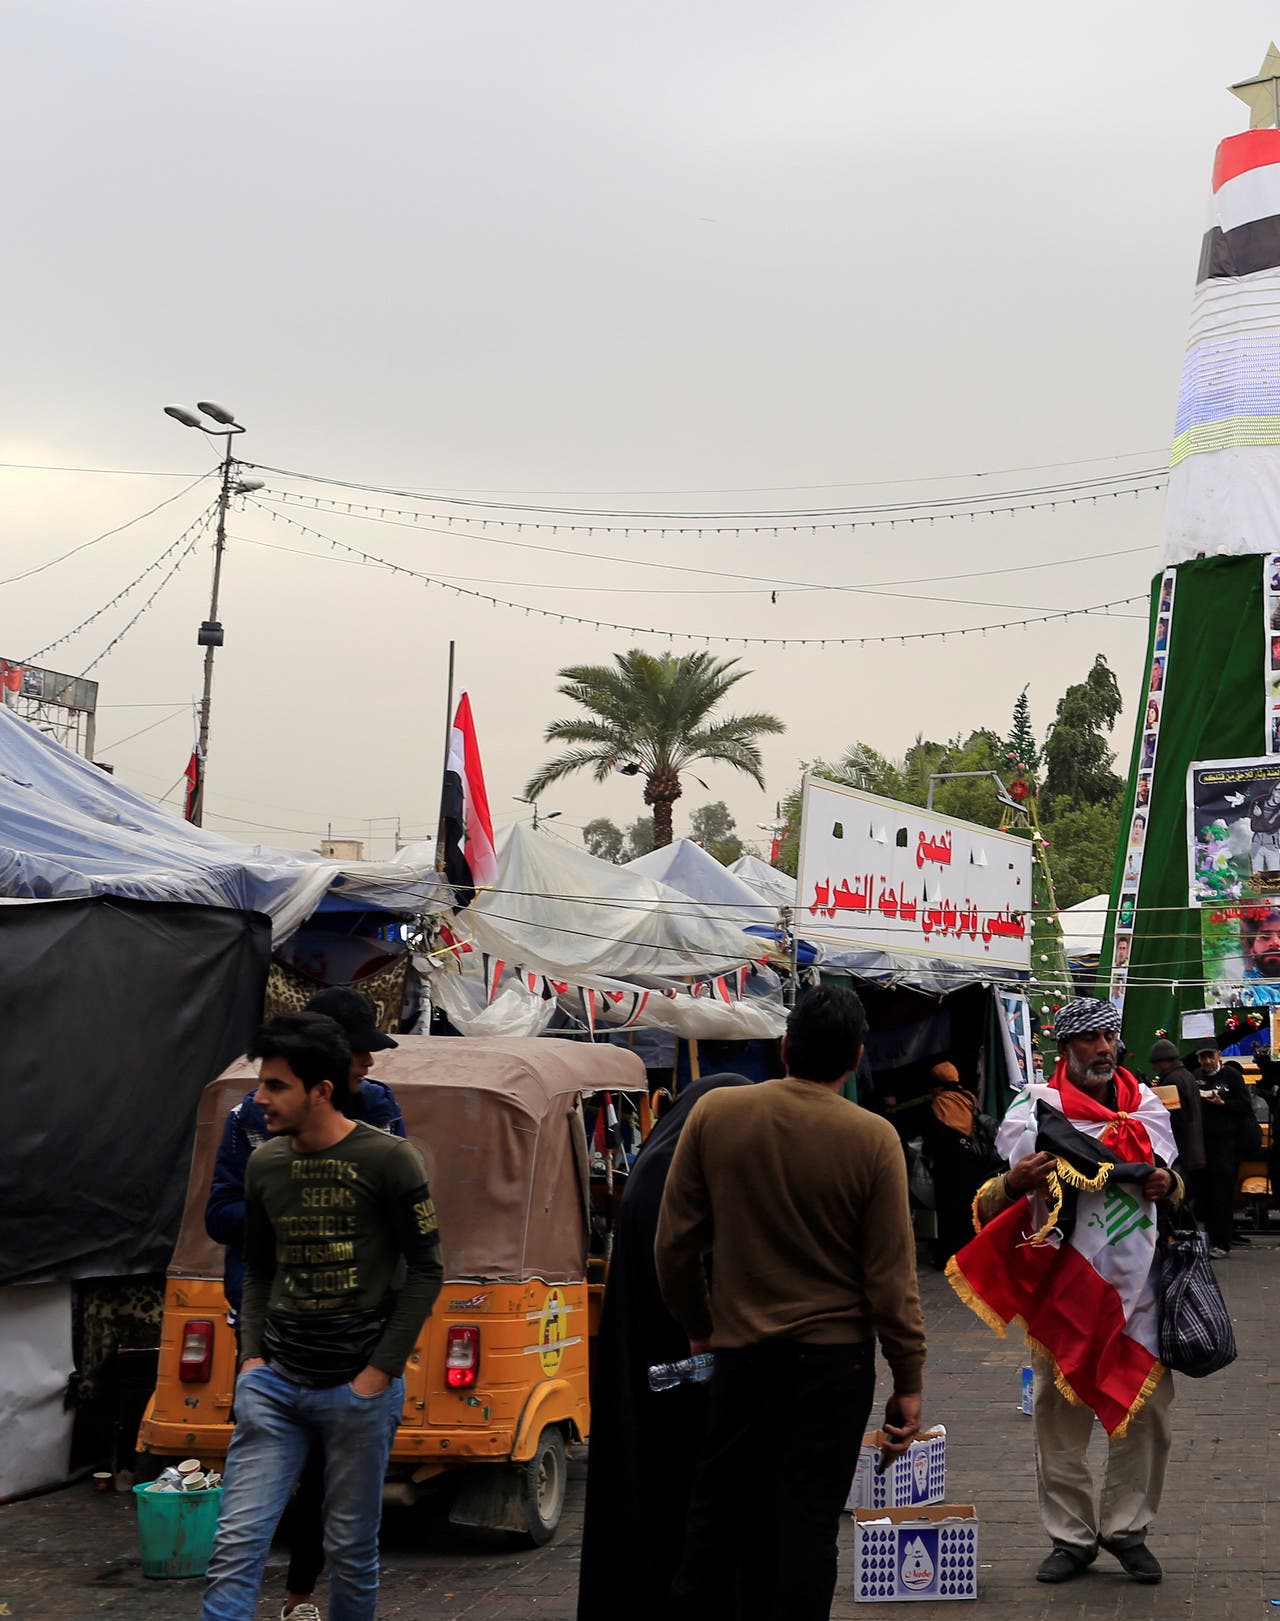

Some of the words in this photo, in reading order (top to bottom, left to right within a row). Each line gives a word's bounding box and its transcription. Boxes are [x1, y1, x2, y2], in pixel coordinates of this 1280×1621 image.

[916, 830, 952, 873] تجمع
[809, 873, 874, 919] التحرير
[878, 875, 917, 921] ساحة
[291, 1158, 359, 1180] ALWAYS
[302, 1187, 357, 1208] SEEMS
[305, 1241, 354, 1264] FASHION
